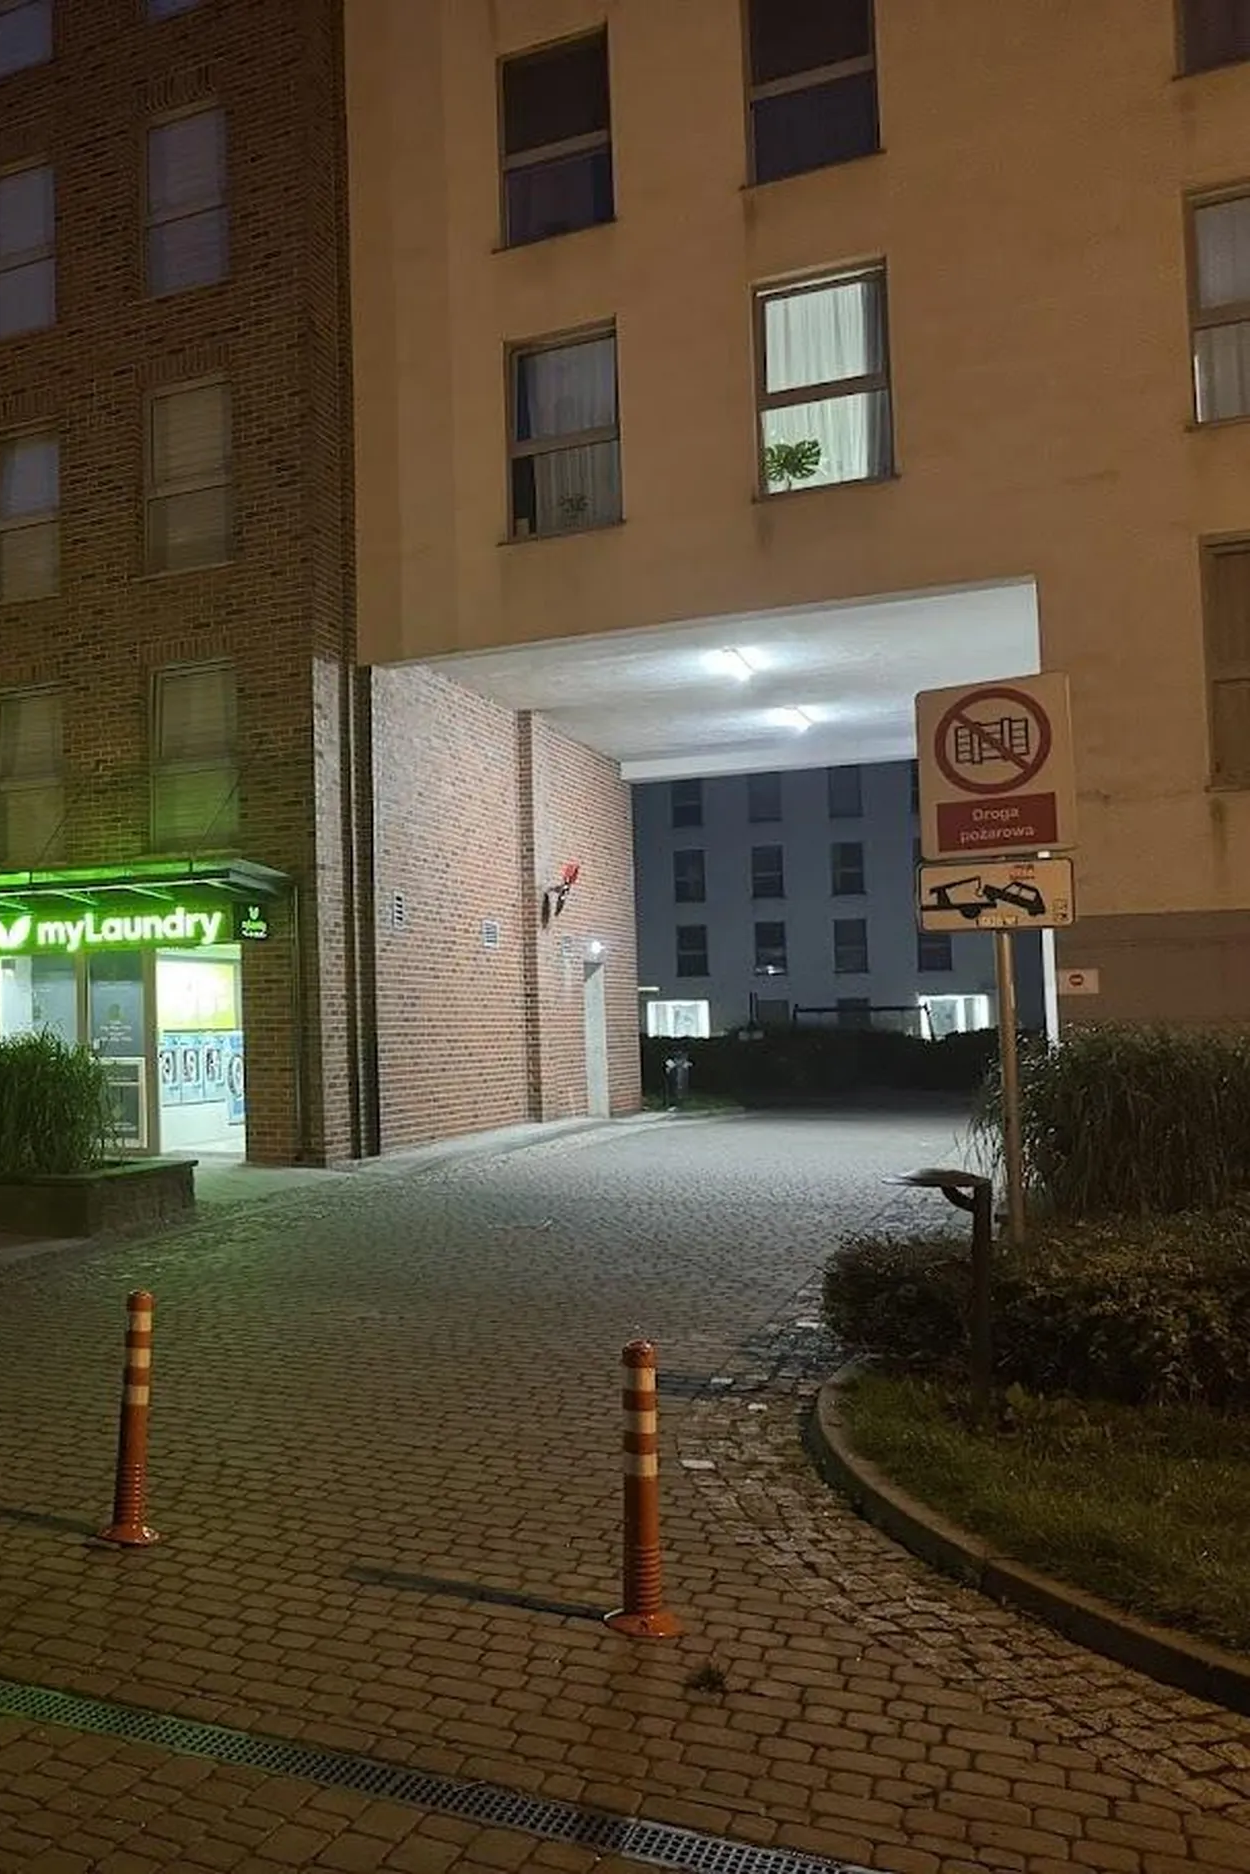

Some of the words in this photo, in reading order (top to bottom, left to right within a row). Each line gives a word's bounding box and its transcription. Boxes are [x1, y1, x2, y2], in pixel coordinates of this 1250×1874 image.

[972, 807, 1020, 821] Droga
[960, 826, 1035, 844] pożarowa
[36, 907, 222, 952] myLaundry
